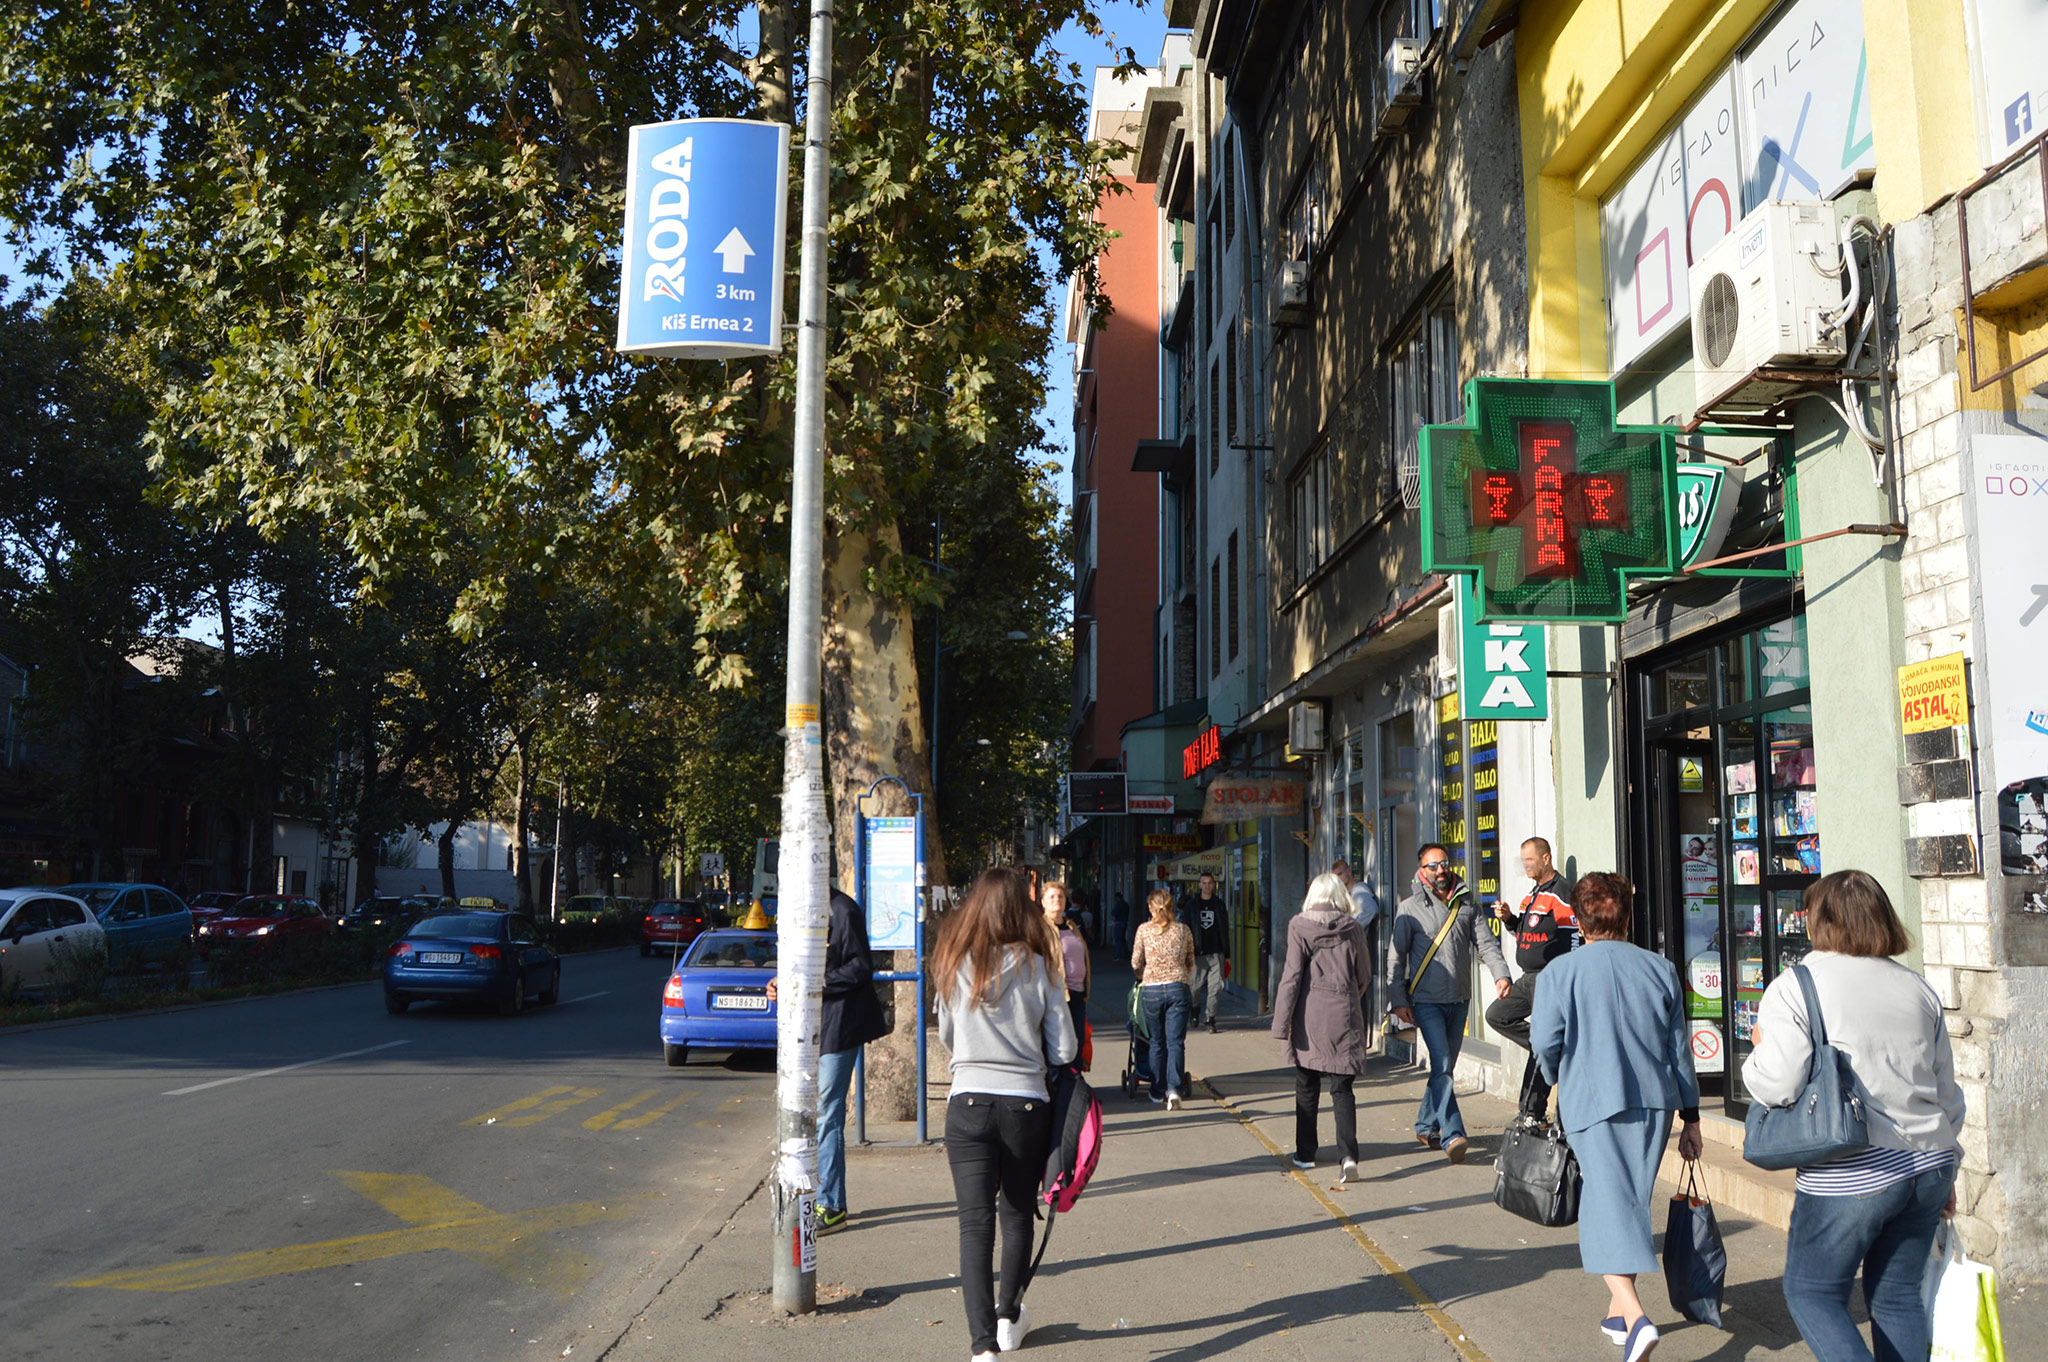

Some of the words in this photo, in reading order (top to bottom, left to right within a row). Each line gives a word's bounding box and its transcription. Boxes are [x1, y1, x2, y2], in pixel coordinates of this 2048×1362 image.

[643, 136, 693, 302] RODA
[716, 284, 727, 299] 3
[729, 285, 755, 301] km
[662, 312, 687, 330] Kiš
[690, 315, 739, 331] Ernea
[742, 317, 753, 332] 2
[1931, 663, 1960, 673] KUHINJA
[1901, 674, 1961, 698] VOJVOĐANSKI
[1904, 693, 1949, 724] ASTAL
[1474, 768, 1497, 791] HALO
[1213, 786, 1294, 804] STOLAR
[1477, 814, 1495, 831] HALO
[1479, 879, 1496, 893] HALO
